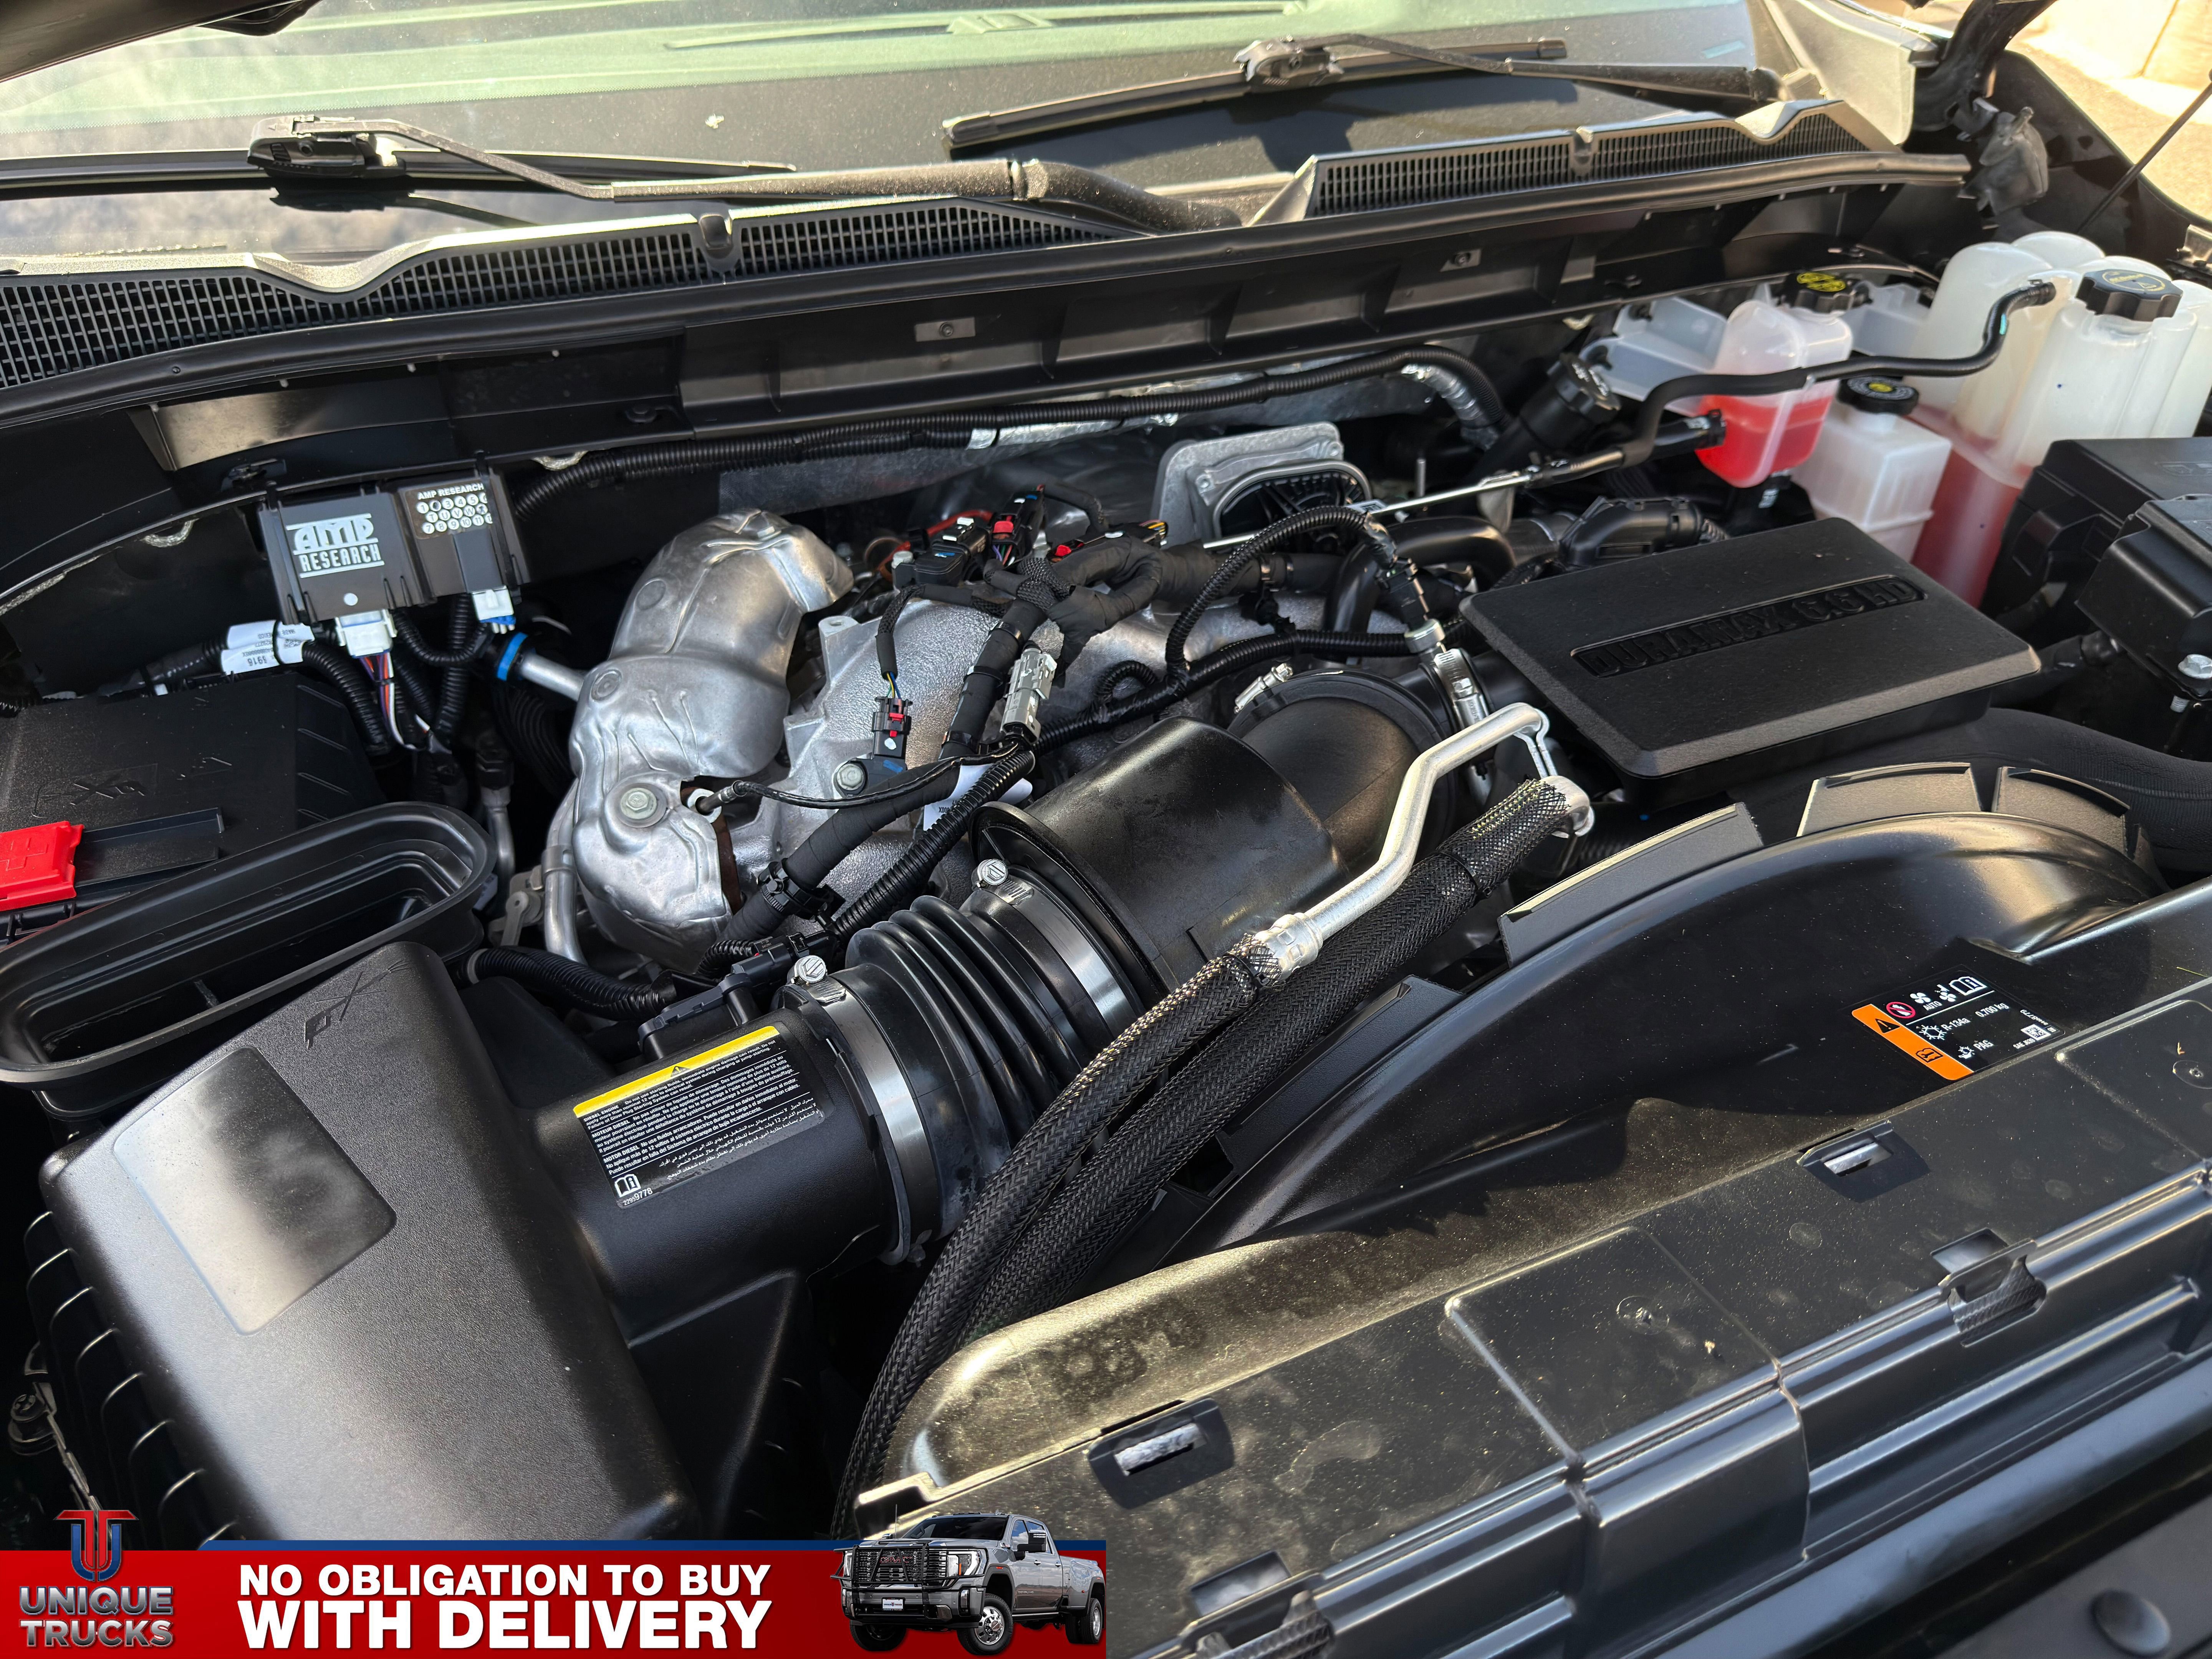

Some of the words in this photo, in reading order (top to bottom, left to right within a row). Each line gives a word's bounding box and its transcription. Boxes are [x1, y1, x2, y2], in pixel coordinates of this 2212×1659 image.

[417, 490, 437, 500] AMP
[437, 483, 484, 497] RESEARCH
[293, 517, 374, 553] AMP
[299, 543, 381, 572] RESEARCH
[1923, 1001, 1942, 1011] AUTO
[1940, 1018, 1971, 1031] R-134a
[1975, 1004, 1998, 1017] 0.700
[1994, 1002, 2010, 1010] kg
[1973, 1040, 1994, 1051] PAG
[583, 1113, 601, 1122] DIESEL
[601, 1105, 619, 1114] ENGINE
[649, 1085, 667, 1094] starting
[681, 1070, 705, 1081] Immediate
[721, 1056, 738, 1065] damage
[591, 1126, 613, 1138] MOTEUR
[613, 1119, 631, 1129] DIESEL
[649, 1104, 666, 1114] utiliser
[672, 1095, 688, 1104] liquide
[730, 1068, 755, 1080] dommages
[754, 1058, 777, 1070] immédiats
[623, 1100, 641, 1110] nominal
[665, 1082, 685, 1093] electrical
[685, 1076, 701, 1084] system
[716, 1061, 735, 1072] charging
[588, 1121, 604, 1130] Failure
[634, 1101, 652, 1111] Starting
[652, 1094, 670, 1103] System
[603, 1141, 621, 1152] pourrait
[628, 1131, 646, 1141] résulter
[655, 1117, 679, 1129] défaillance
[686, 1106, 705, 1116] système
[712, 1093, 737, 1105] démarrage
[740, 1083, 758, 1093] bougies
[603, 1152, 622, 1163] MOTOR
[622, 1145, 640, 1155] DIESEL
[657, 1131, 673, 1140] fluidos
[672, 1119, 704, 1134] arrancadores.
[703, 1112, 718, 1121] Puede
[717, 1104, 735, 1114] resultar
[741, 1096, 755, 1104] daños
[783, 1078, 798, 1086] motor.
[613, 1156, 631, 1166] aplique
[654, 1139, 670, 1148] voltios
[675, 1129, 694, 1140] sistema
[694, 1121, 714, 1132] eléctrico
[713, 1113, 730, 1123] durante
[735, 1106, 748, 1114] carga
[756, 1094, 776, 1104] arranque
[784, 1084, 800, 1093] cables.
[608, 1166, 624, 1175] Puede
[624, 1158, 642, 1169] resultar
[666, 1139, 687, 1150] Sistema
[692, 1128, 713, 1139] arranque
[729, 1107, 763, 1123] incandescente.
[623, 1187, 653, 1205] 22959778
